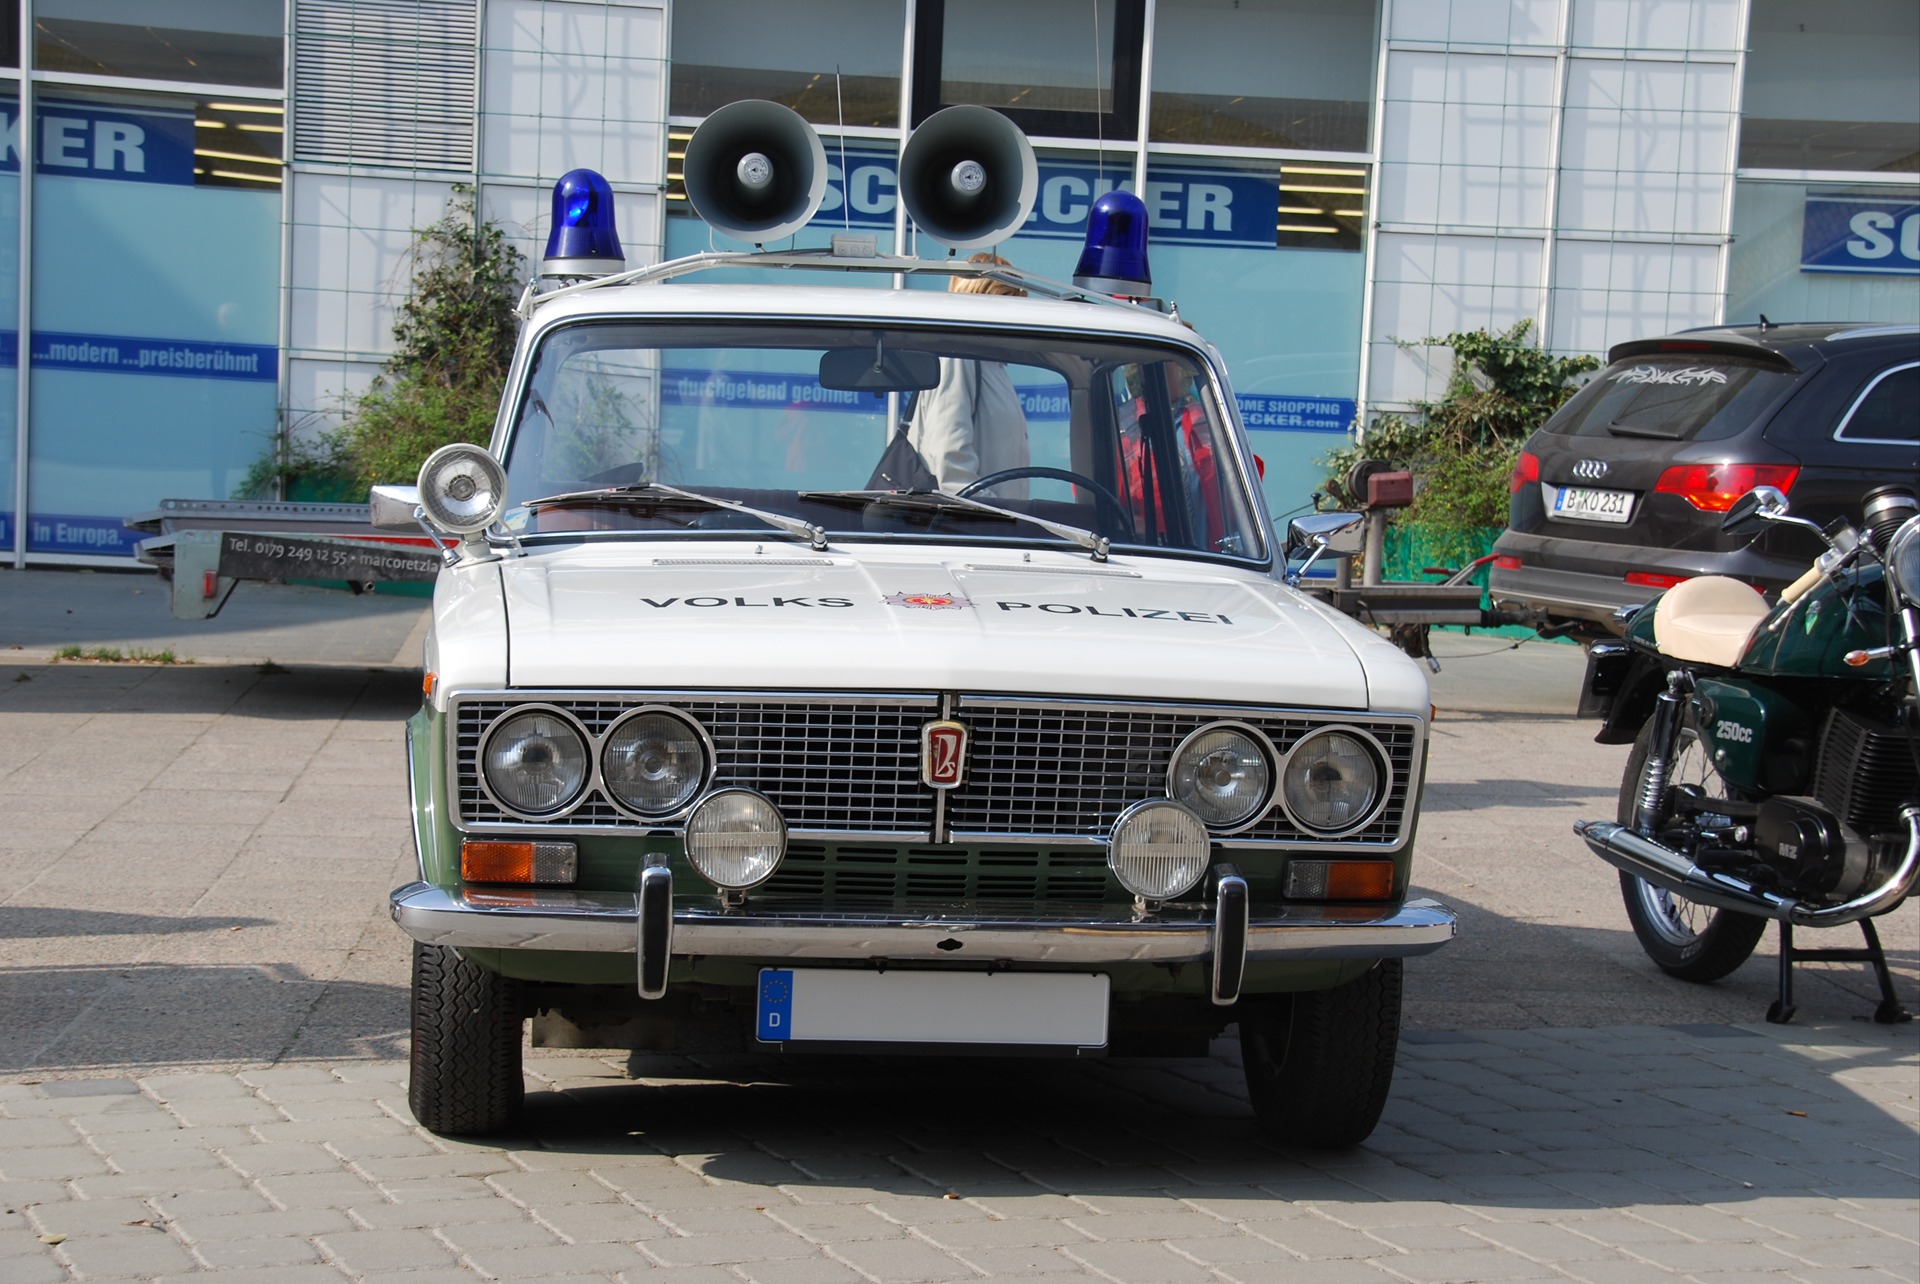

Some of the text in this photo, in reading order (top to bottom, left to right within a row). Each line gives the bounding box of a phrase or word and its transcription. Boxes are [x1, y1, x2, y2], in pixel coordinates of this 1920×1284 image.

[32, 343, 258, 373] ...modern ...preisberühmt
[1268, 401, 1340, 415] SHOPPING
[1567, 490, 1577, 508] B
[1601, 493, 1626, 514] 231
[33, 522, 123, 547] in Europa.
[230, 538, 251, 552] Tel.
[255, 543, 285, 558] 0179
[287, 546, 313, 561] 249
[316, 549, 329, 561] 12
[332, 551, 347, 565] 55
[640, 597, 1234, 625] VOLKS POLIZEI
[1778, 842, 1798, 860] MZ
[769, 1012, 781, 1027] D
